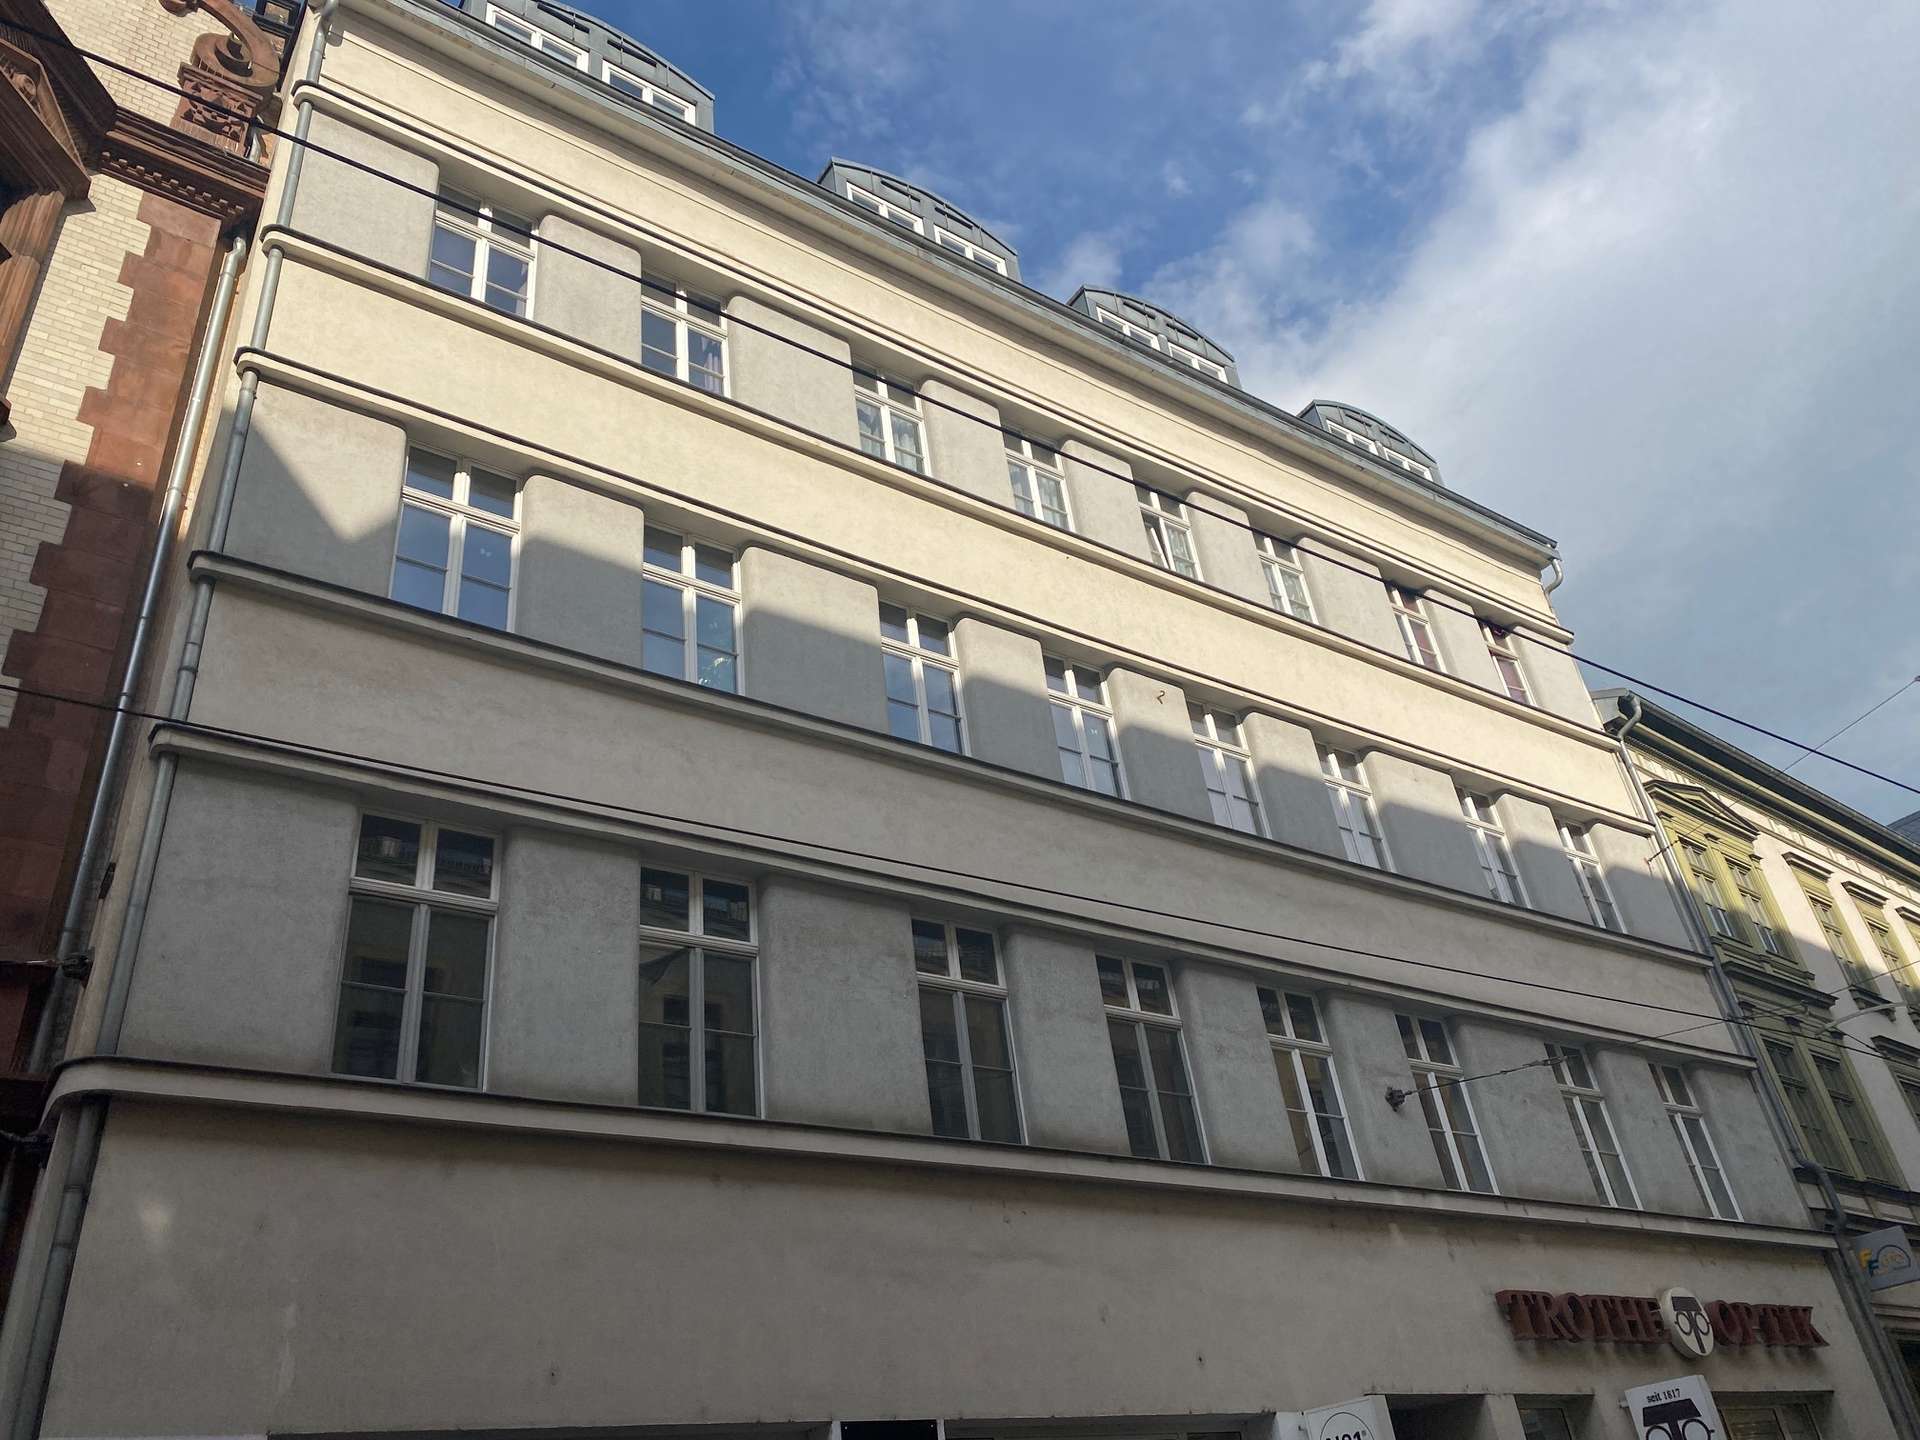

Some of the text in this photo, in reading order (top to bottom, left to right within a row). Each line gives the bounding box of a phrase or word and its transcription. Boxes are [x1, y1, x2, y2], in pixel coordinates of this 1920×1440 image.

[1496, 1289, 1830, 1347] TROTHE OPTIK
[1646, 1391, 1662, 1403] seit
